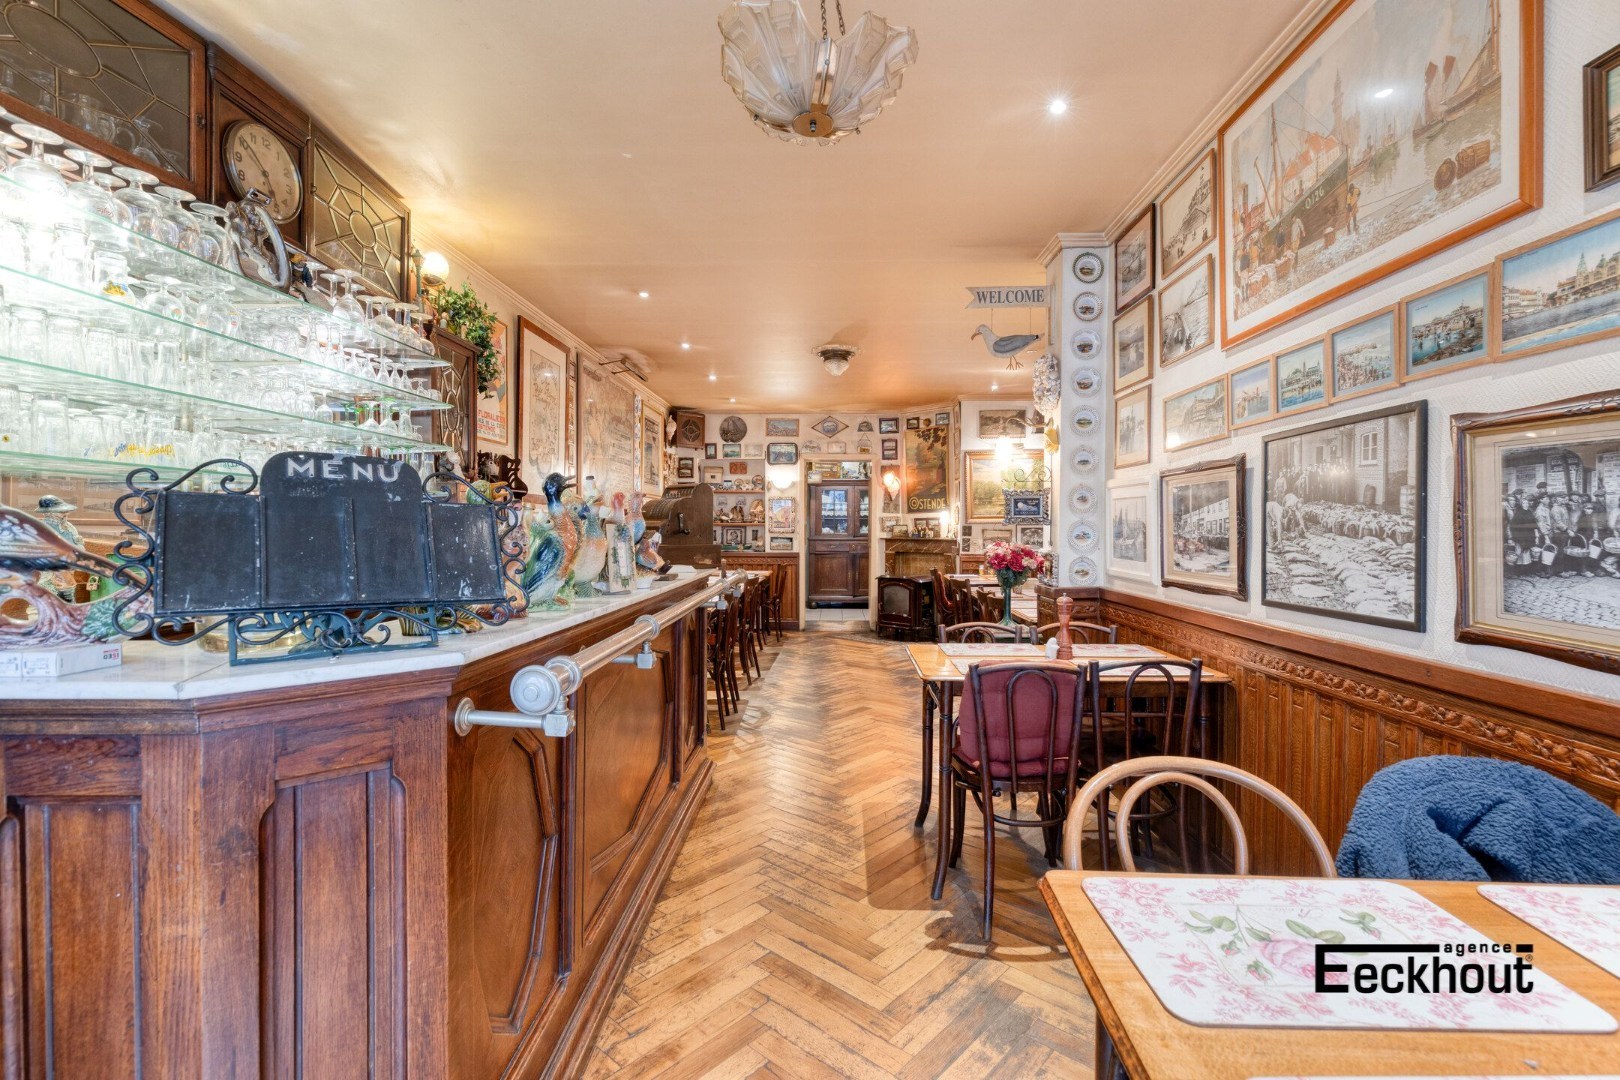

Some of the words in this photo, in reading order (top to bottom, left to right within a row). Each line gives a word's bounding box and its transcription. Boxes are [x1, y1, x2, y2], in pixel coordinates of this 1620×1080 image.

[250, 132, 256, 144] 11
[262, 136, 271, 150] 12
[235, 152, 242, 162] 9
[276, 152, 280, 161] 1
[238, 170, 245, 180] 8
[284, 168, 290, 178] 2
[286, 184, 292, 195] 3
[282, 199, 288, 209] 4
[976, 289, 1045, 304] WELCOME
[909, 496, 946, 510] OSTENDE
